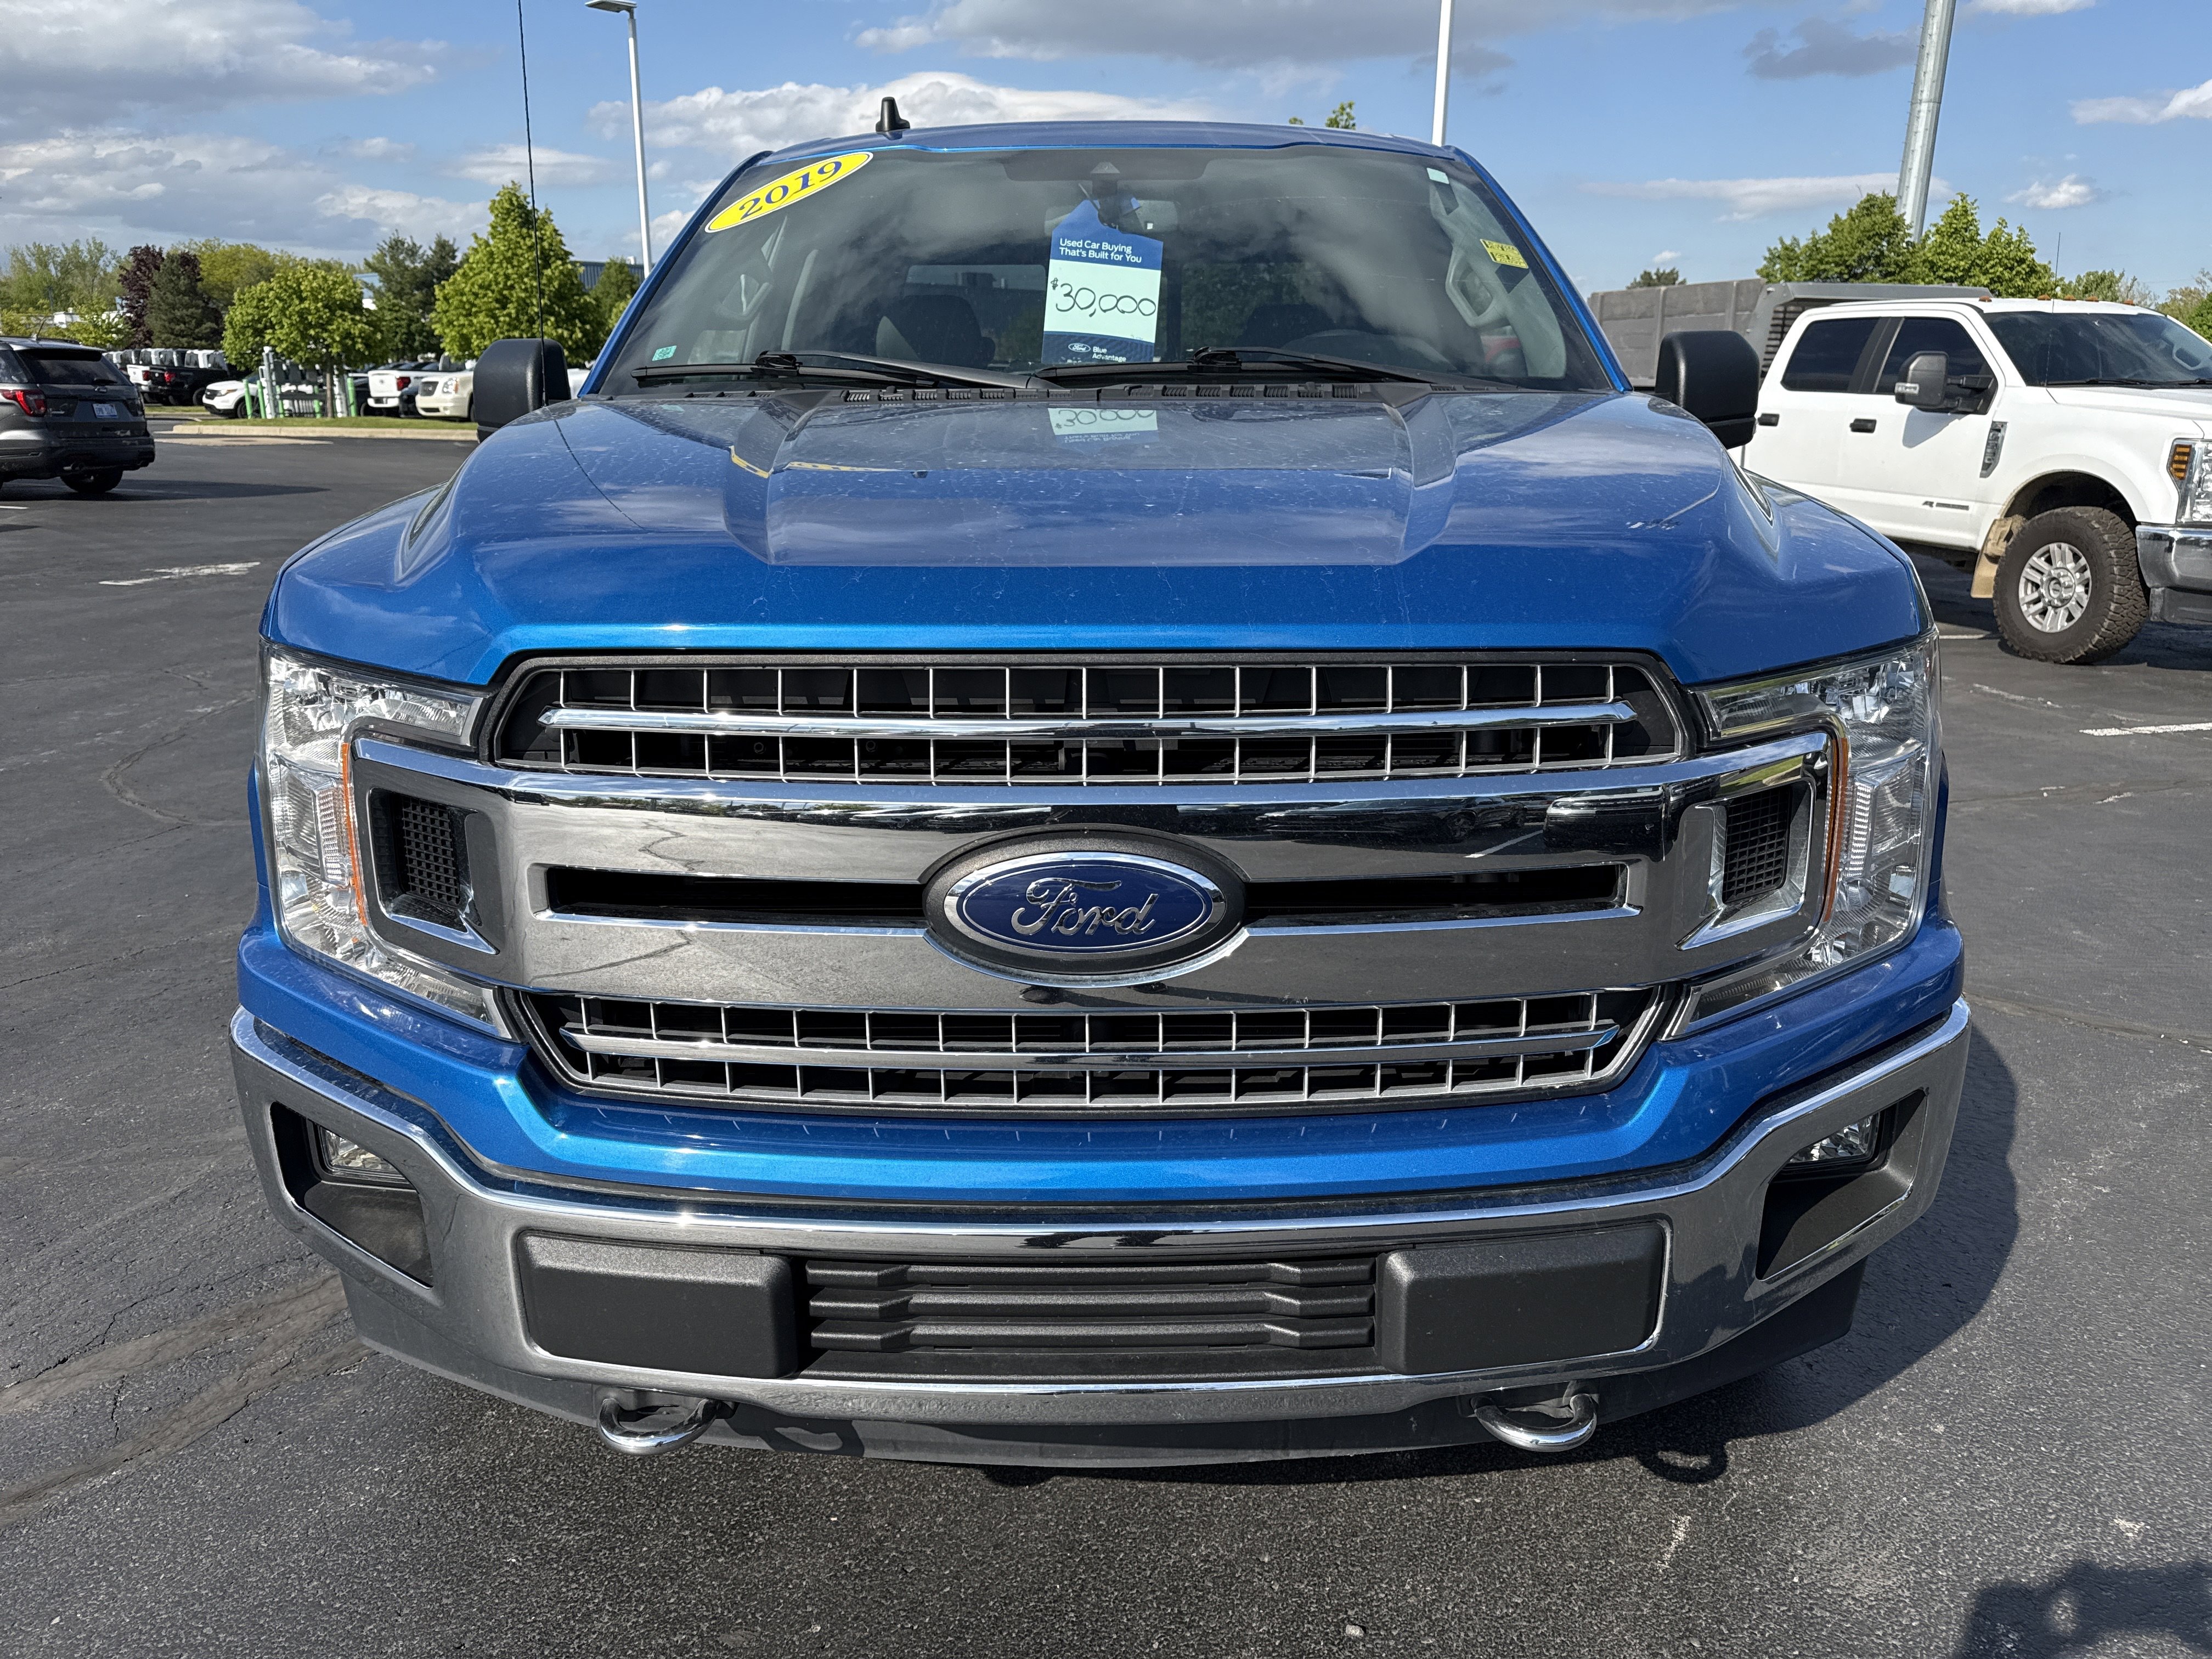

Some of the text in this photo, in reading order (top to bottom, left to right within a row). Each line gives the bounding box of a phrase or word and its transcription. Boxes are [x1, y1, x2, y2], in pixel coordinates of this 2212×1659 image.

[738, 160, 842, 220] 2019
[1059, 238, 1132, 254] Used Car Buying
[1059, 247, 1142, 263] That's Built for You
[1051, 278, 1156, 318] $30,000
[1092, 353, 1127, 362] Advantage
[1011, 877, 1159, 935] Ford
